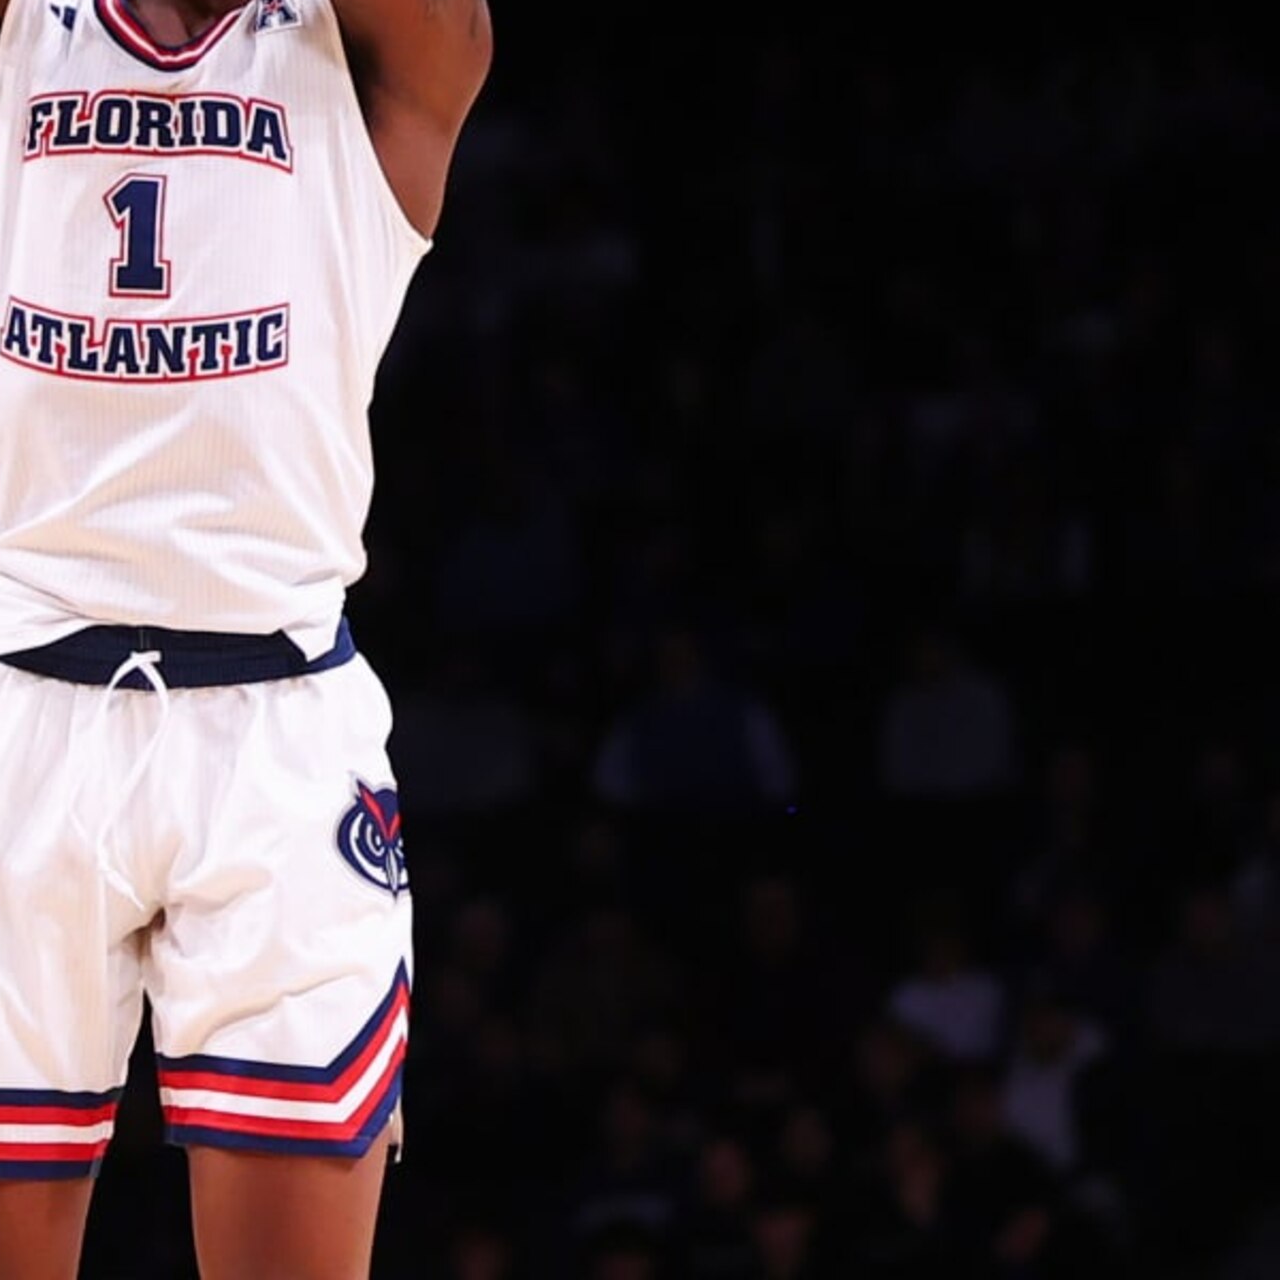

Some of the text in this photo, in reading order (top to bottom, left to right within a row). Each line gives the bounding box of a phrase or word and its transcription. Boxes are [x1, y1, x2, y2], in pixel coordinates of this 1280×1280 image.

[24, 91, 292, 172] FLORIDA
[104, 173, 170, 298] 1
[0, 298, 289, 382] ATLANTIC
